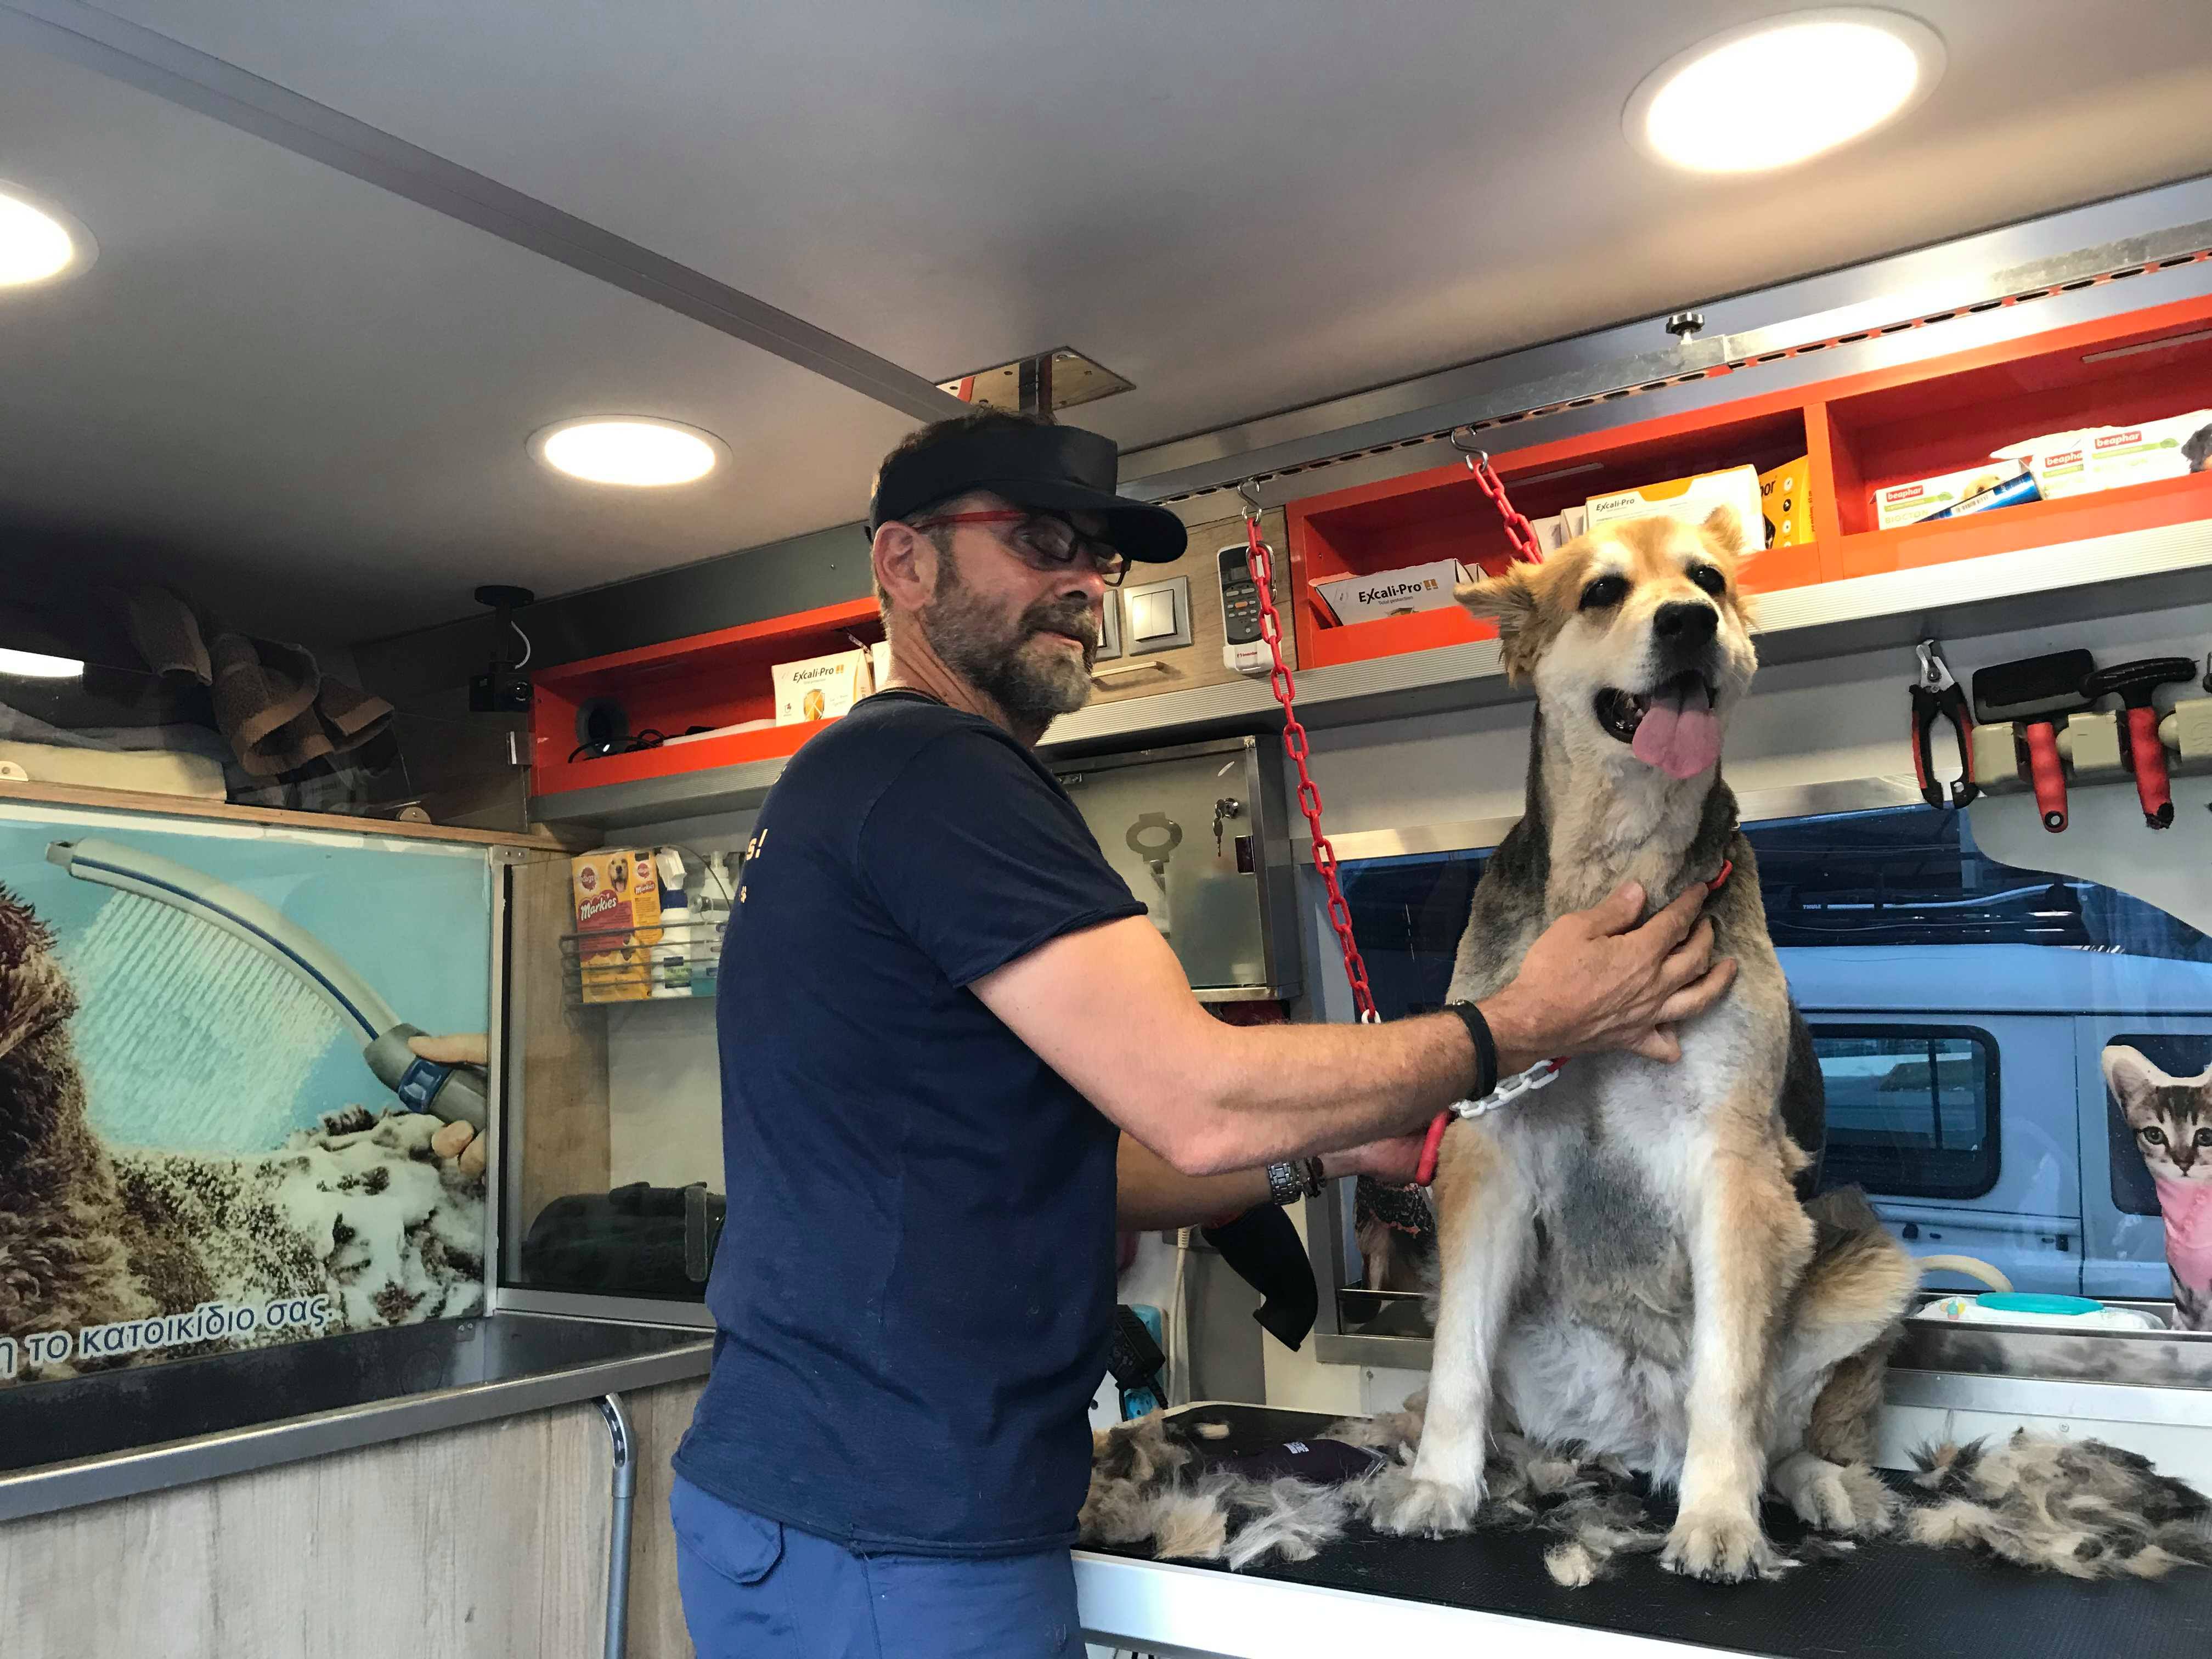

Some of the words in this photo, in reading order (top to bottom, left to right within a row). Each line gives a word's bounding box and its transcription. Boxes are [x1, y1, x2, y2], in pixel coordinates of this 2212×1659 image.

[2097, 432, 2140, 447] beaphar
[1888, 487, 1922, 500] beaphar
[1358, 583, 1421, 605] Excali-Pro
[793, 667, 834, 684] Excali-Pro
[580, 893, 617, 921] Markies
[30, 1335, 68, 1360] το
[84, 1305, 254, 1353] κατοικίδιο
[267, 1297, 332, 1327] σας.
